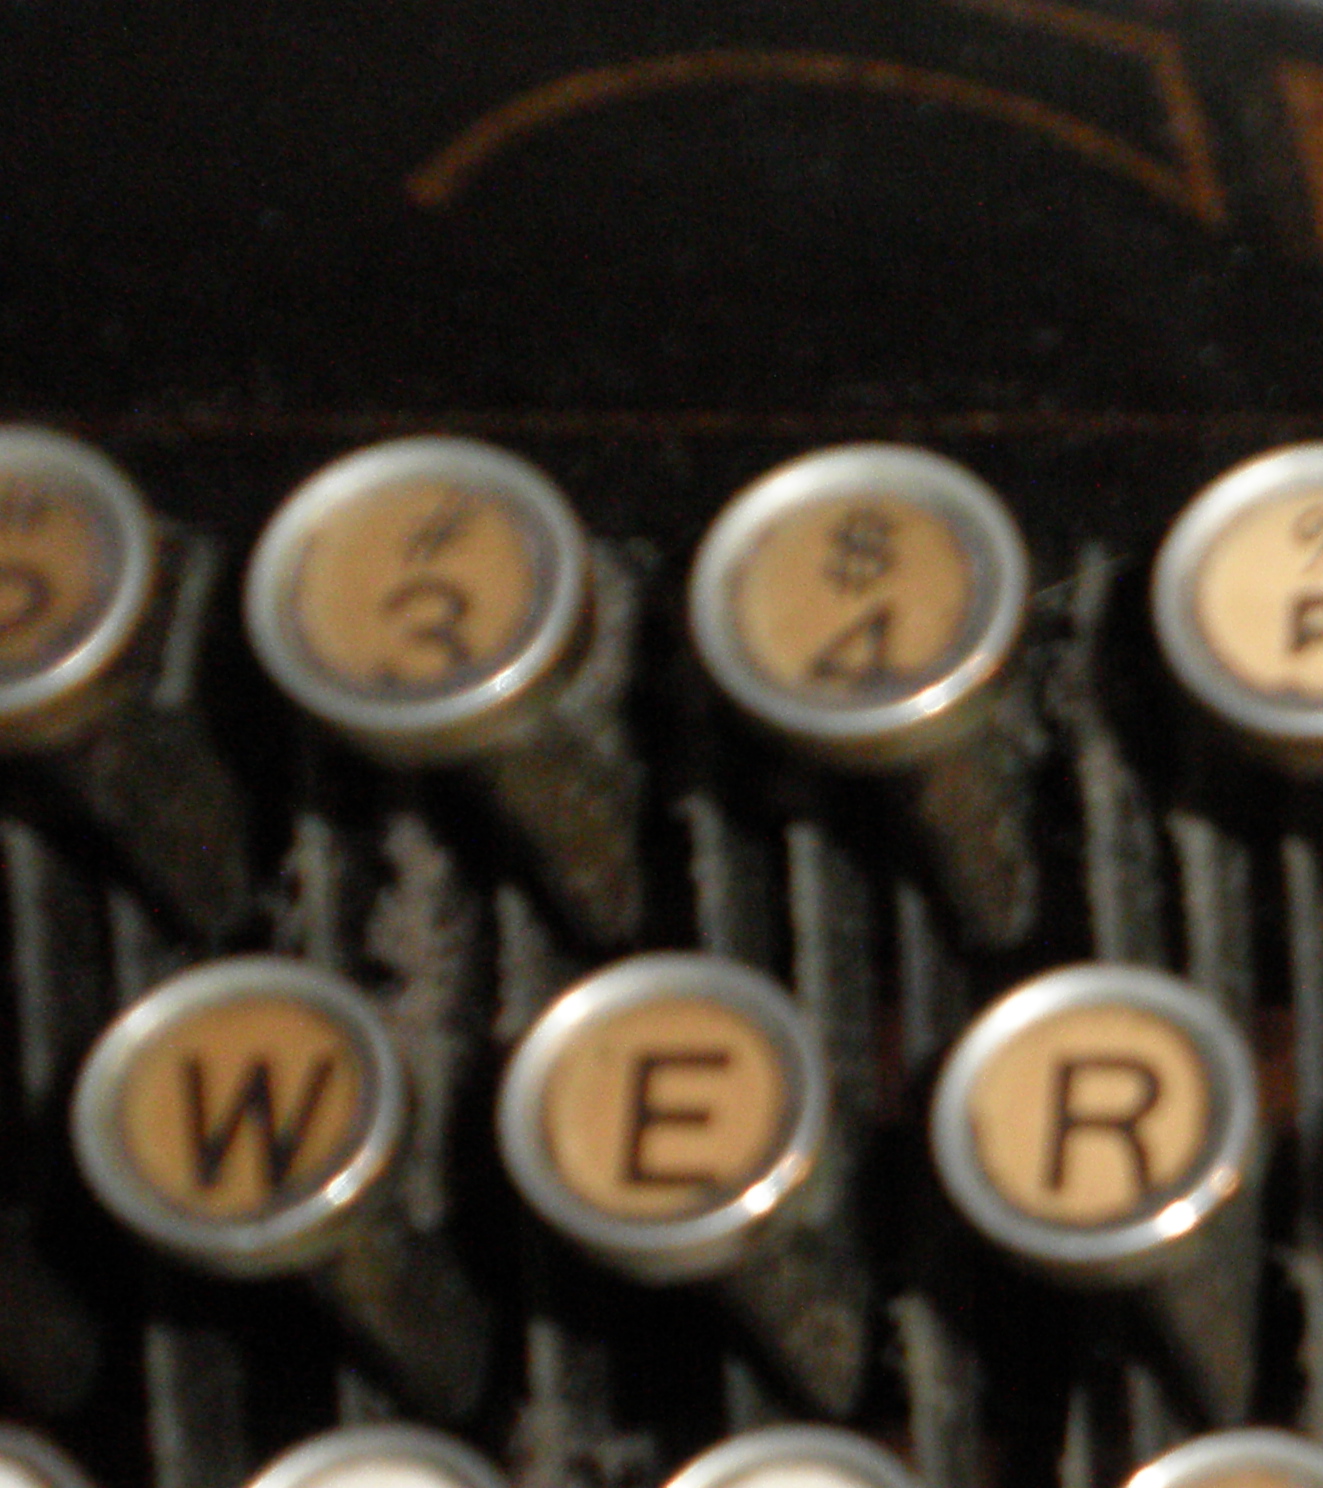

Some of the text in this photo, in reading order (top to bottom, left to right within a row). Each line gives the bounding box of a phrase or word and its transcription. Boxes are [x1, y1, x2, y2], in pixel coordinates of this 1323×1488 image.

[823, 507, 897, 597] $
[378, 572, 473, 690] 3
[812, 604, 895, 687] 4
[178, 1052, 336, 1192] W
[624, 1050, 733, 1190] E
[1046, 1055, 1162, 1194] R
